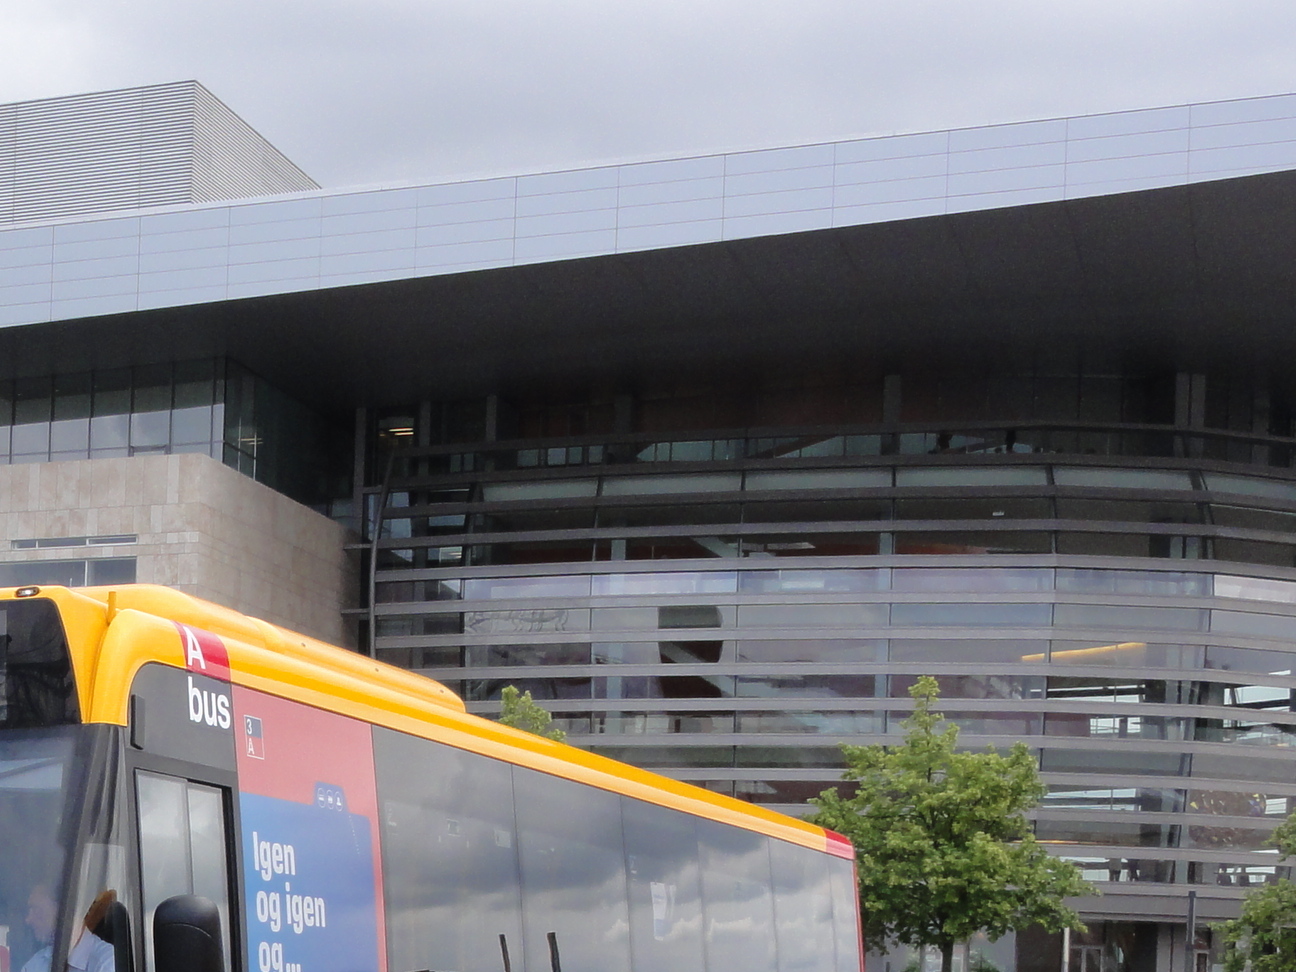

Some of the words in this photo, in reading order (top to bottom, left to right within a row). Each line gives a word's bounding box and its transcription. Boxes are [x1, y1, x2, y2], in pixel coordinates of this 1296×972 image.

[182, 625, 207, 670] A
[187, 676, 232, 730] bus
[252, 831, 296, 882] Igen
[256, 890, 282, 933] og
[285, 882, 326, 935] igen
